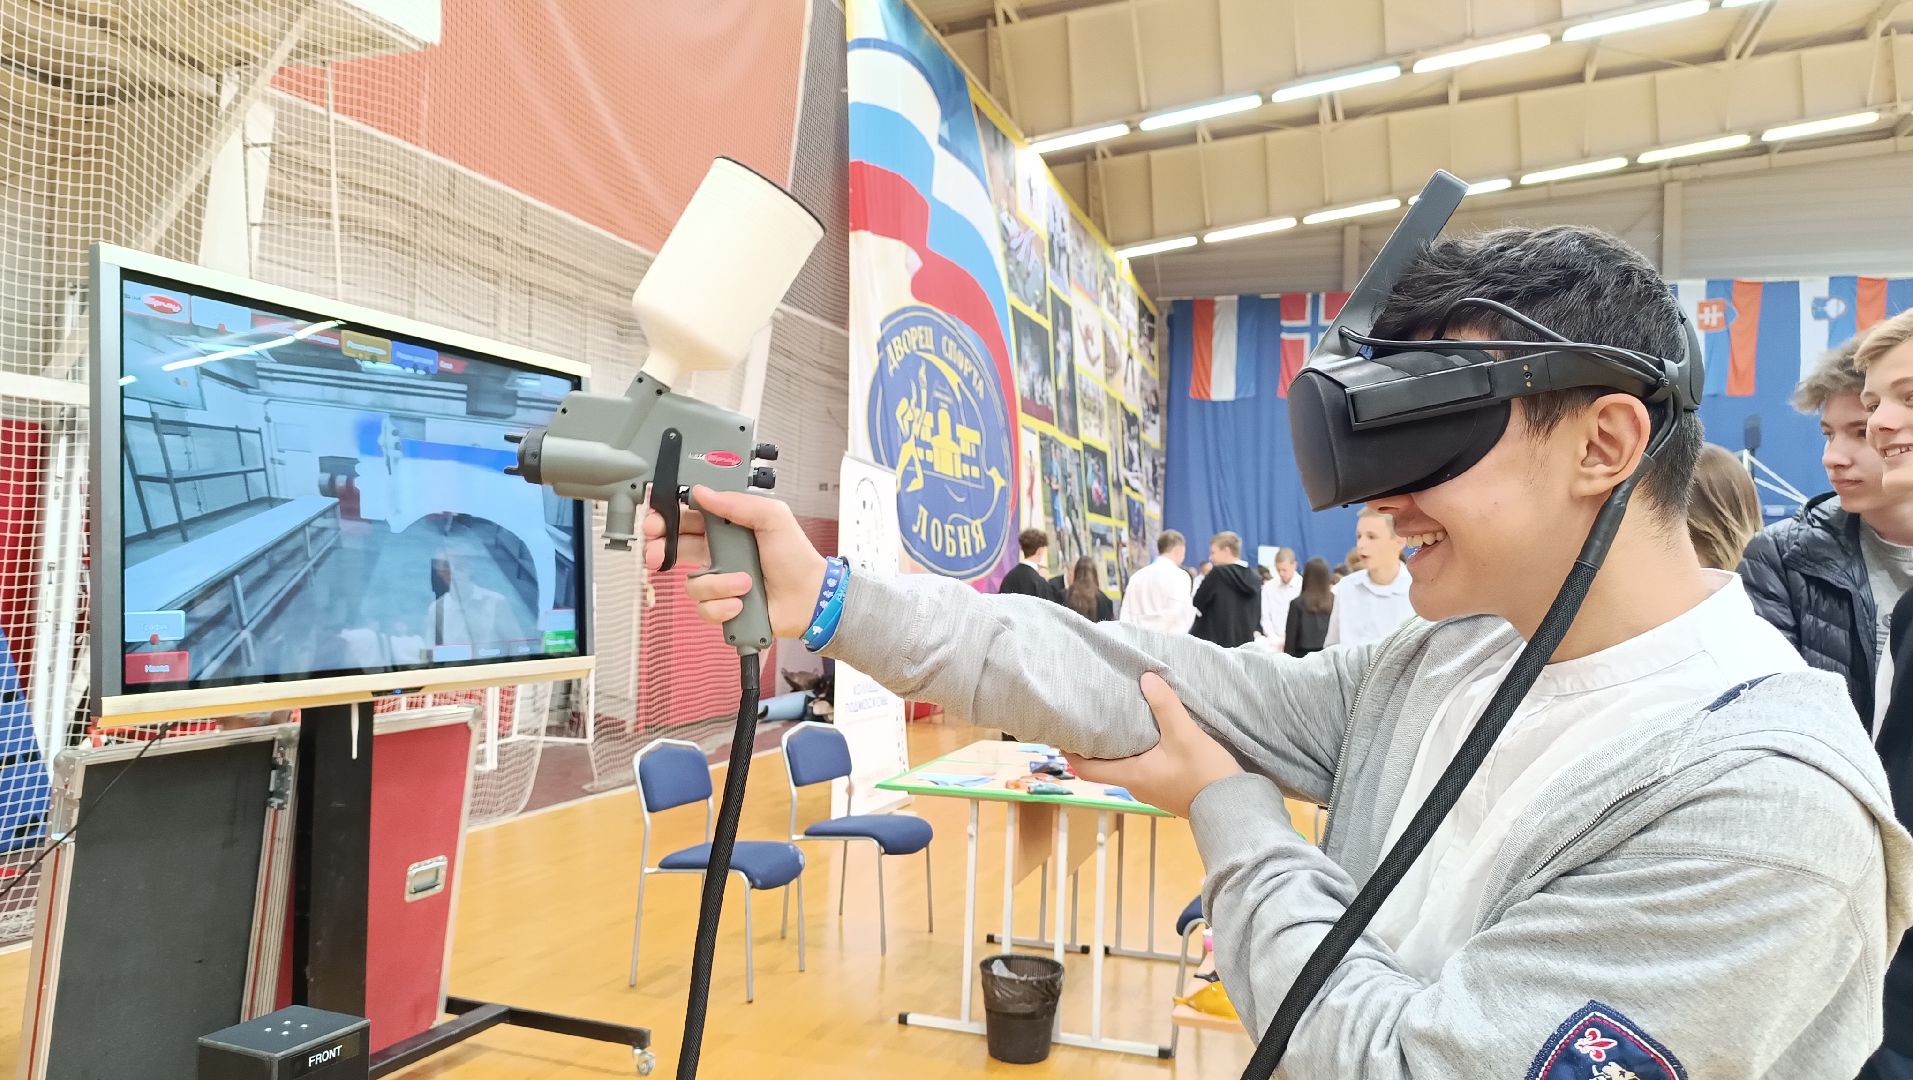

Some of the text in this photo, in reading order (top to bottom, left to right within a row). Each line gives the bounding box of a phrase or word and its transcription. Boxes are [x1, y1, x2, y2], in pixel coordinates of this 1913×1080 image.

[885, 325, 985, 400] ДВОРЕЦ СПОРТА
[912, 503, 987, 558] ЛОБНЯ
[308, 1045, 343, 1067] FRONT
